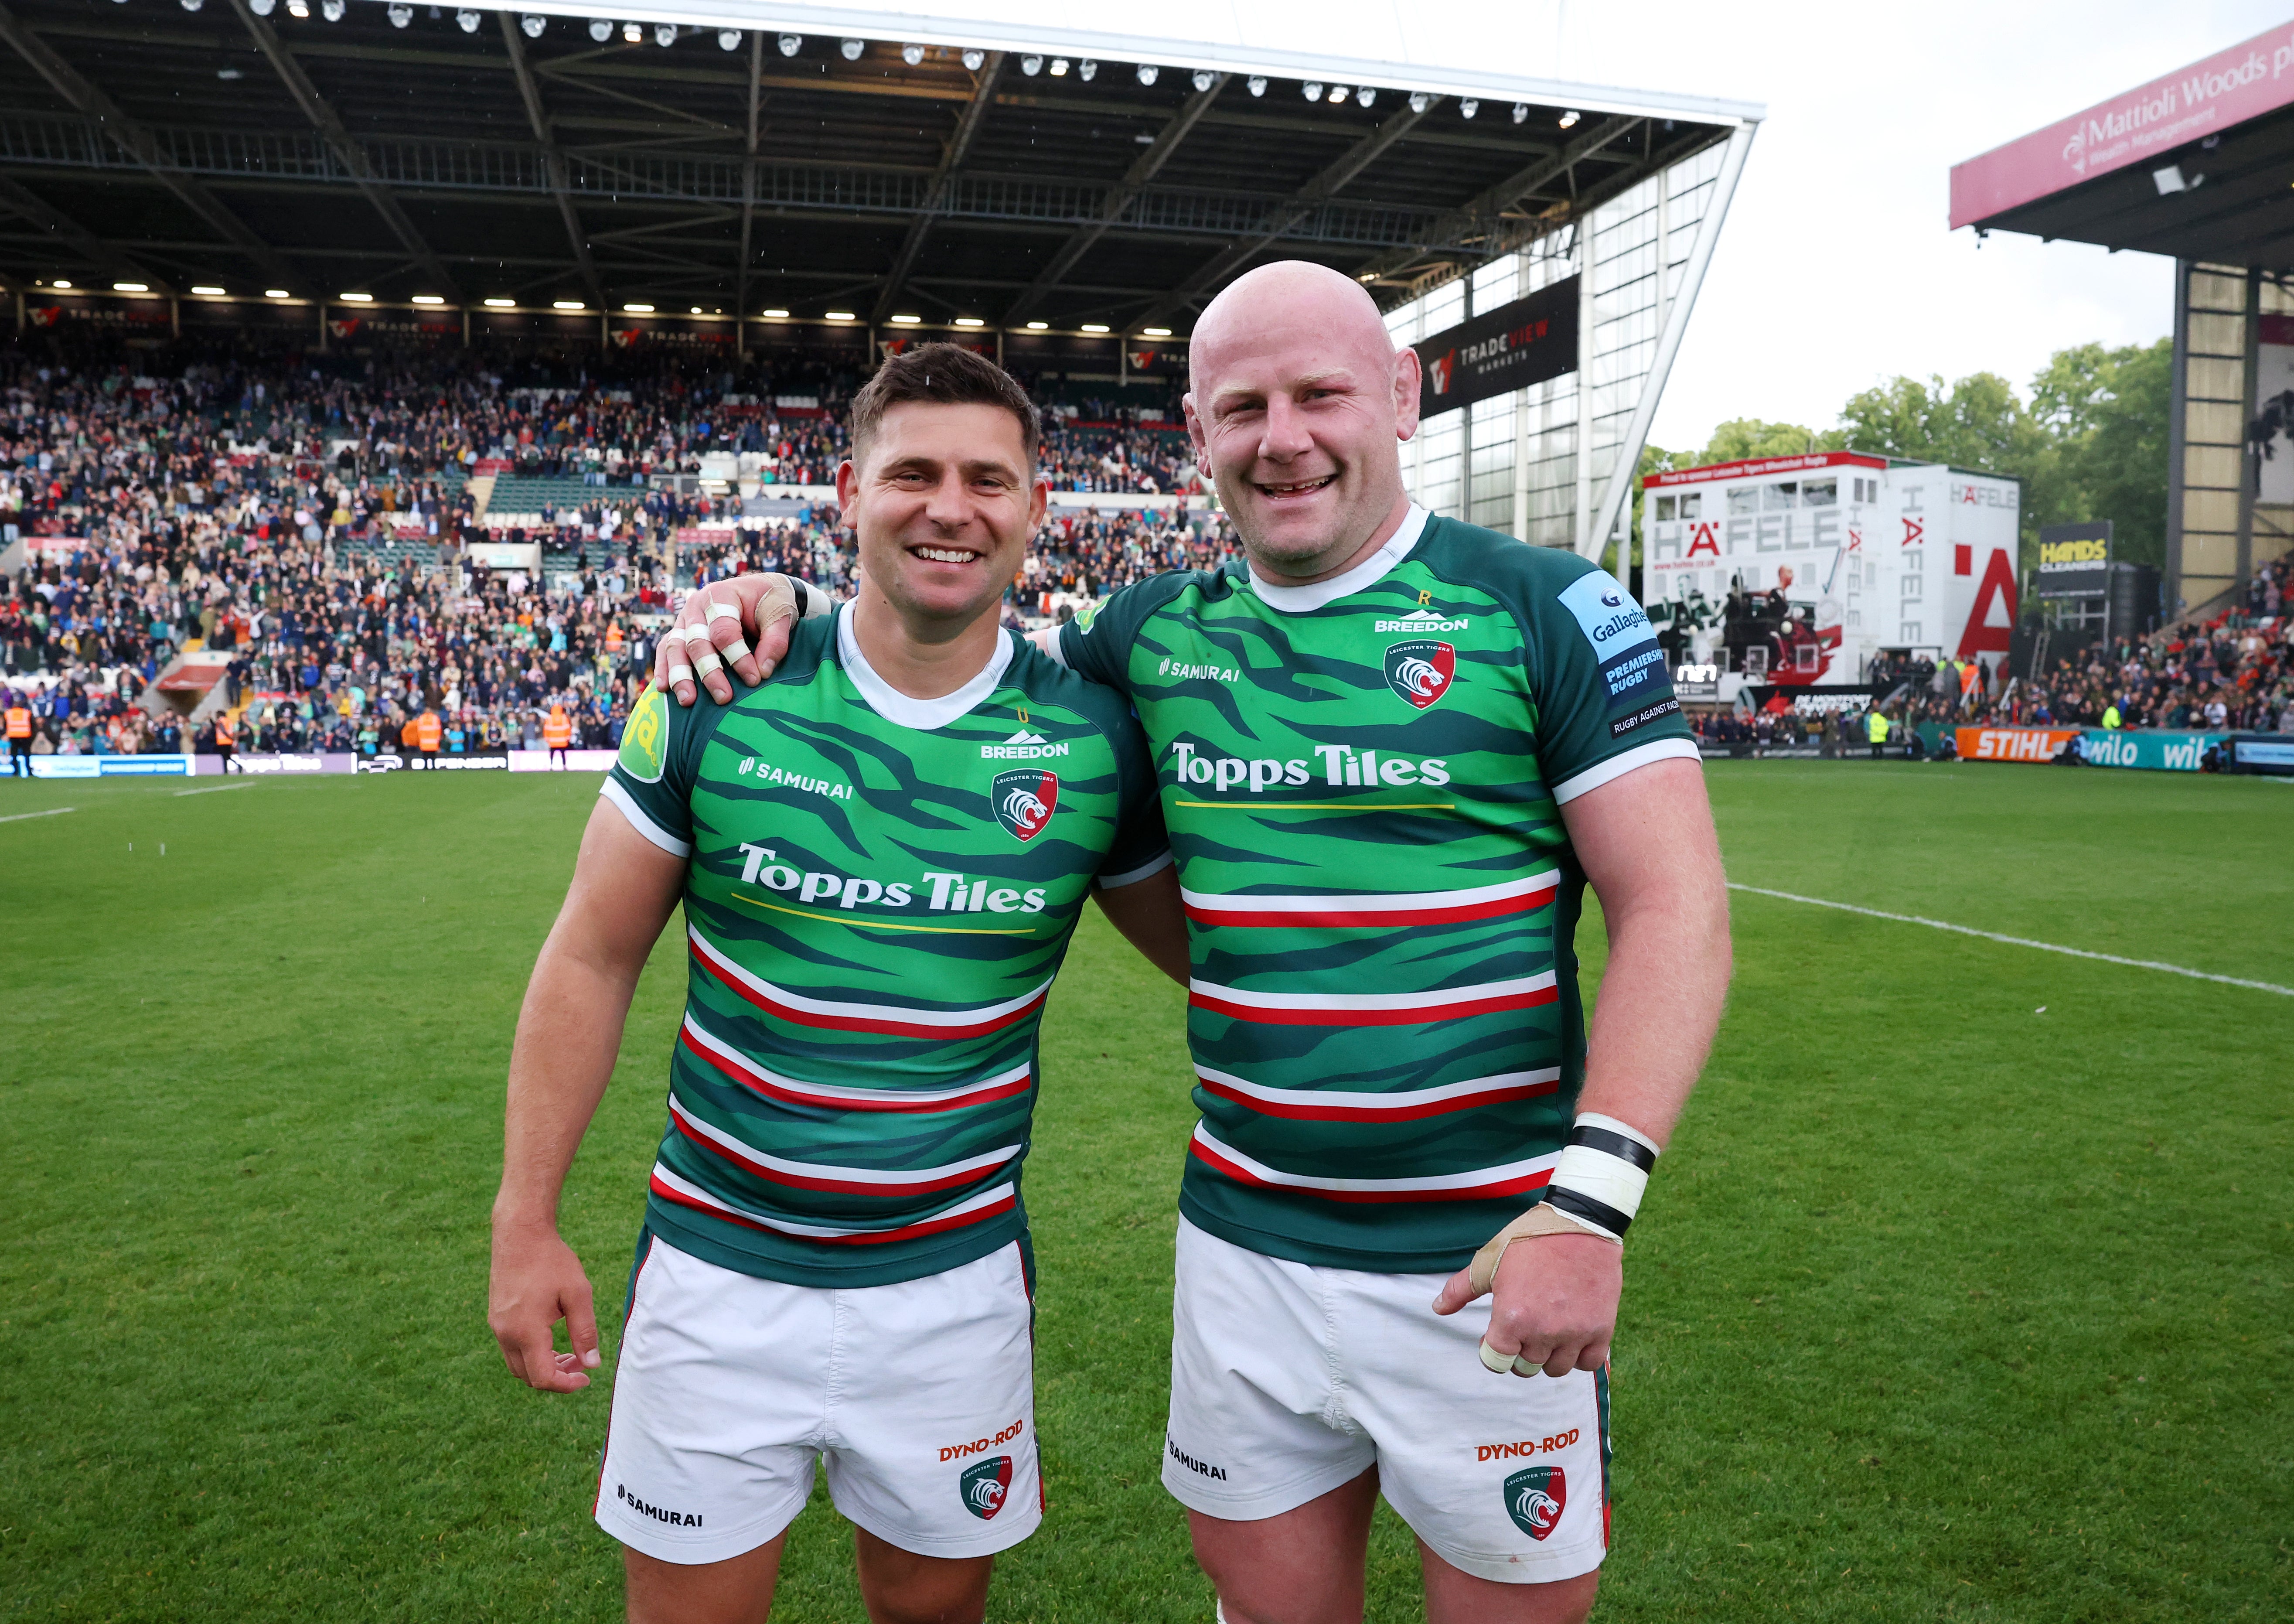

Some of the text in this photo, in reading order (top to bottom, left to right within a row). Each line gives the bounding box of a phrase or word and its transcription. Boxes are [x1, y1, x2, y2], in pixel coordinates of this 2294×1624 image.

[2089, 86, 2176, 146] Mattioli
[2183, 51, 2267, 107] Woods
[1462, 319, 1549, 365] TRADEVIEW
[1418, 590, 1432, 605] R
[1375, 619, 1469, 632] BREEDON
[1389, 645, 1424, 655] LEICESTER
[1171, 662, 1240, 682] SAMURAI
[1610, 667, 1648, 696] RUGBY
[1614, 715, 1638, 734] RUGBY
[1640, 703, 1666, 723] AGAINST
[981, 743, 1069, 759] BREEDON
[1976, 730, 2056, 760] STIHL
[2163, 737, 2206, 768] wil
[756, 763, 853, 799] SAMURAI
[996, 775, 1030, 784] LEICESTER
[1173, 742, 1450, 792] Topps Tiles
[739, 843, 1046, 913] Topps Tiles
[940, 1419, 1023, 1462] DYNO-ROD
[1478, 1428, 1579, 1461] DYNO-ROD
[963, 1464, 990, 1479] LEICESTER
[1169, 1440, 1227, 1481] SAMURAI
[1507, 1474, 1538, 1486] LEICESTER
[627, 1492, 702, 1527] SAMURAI
